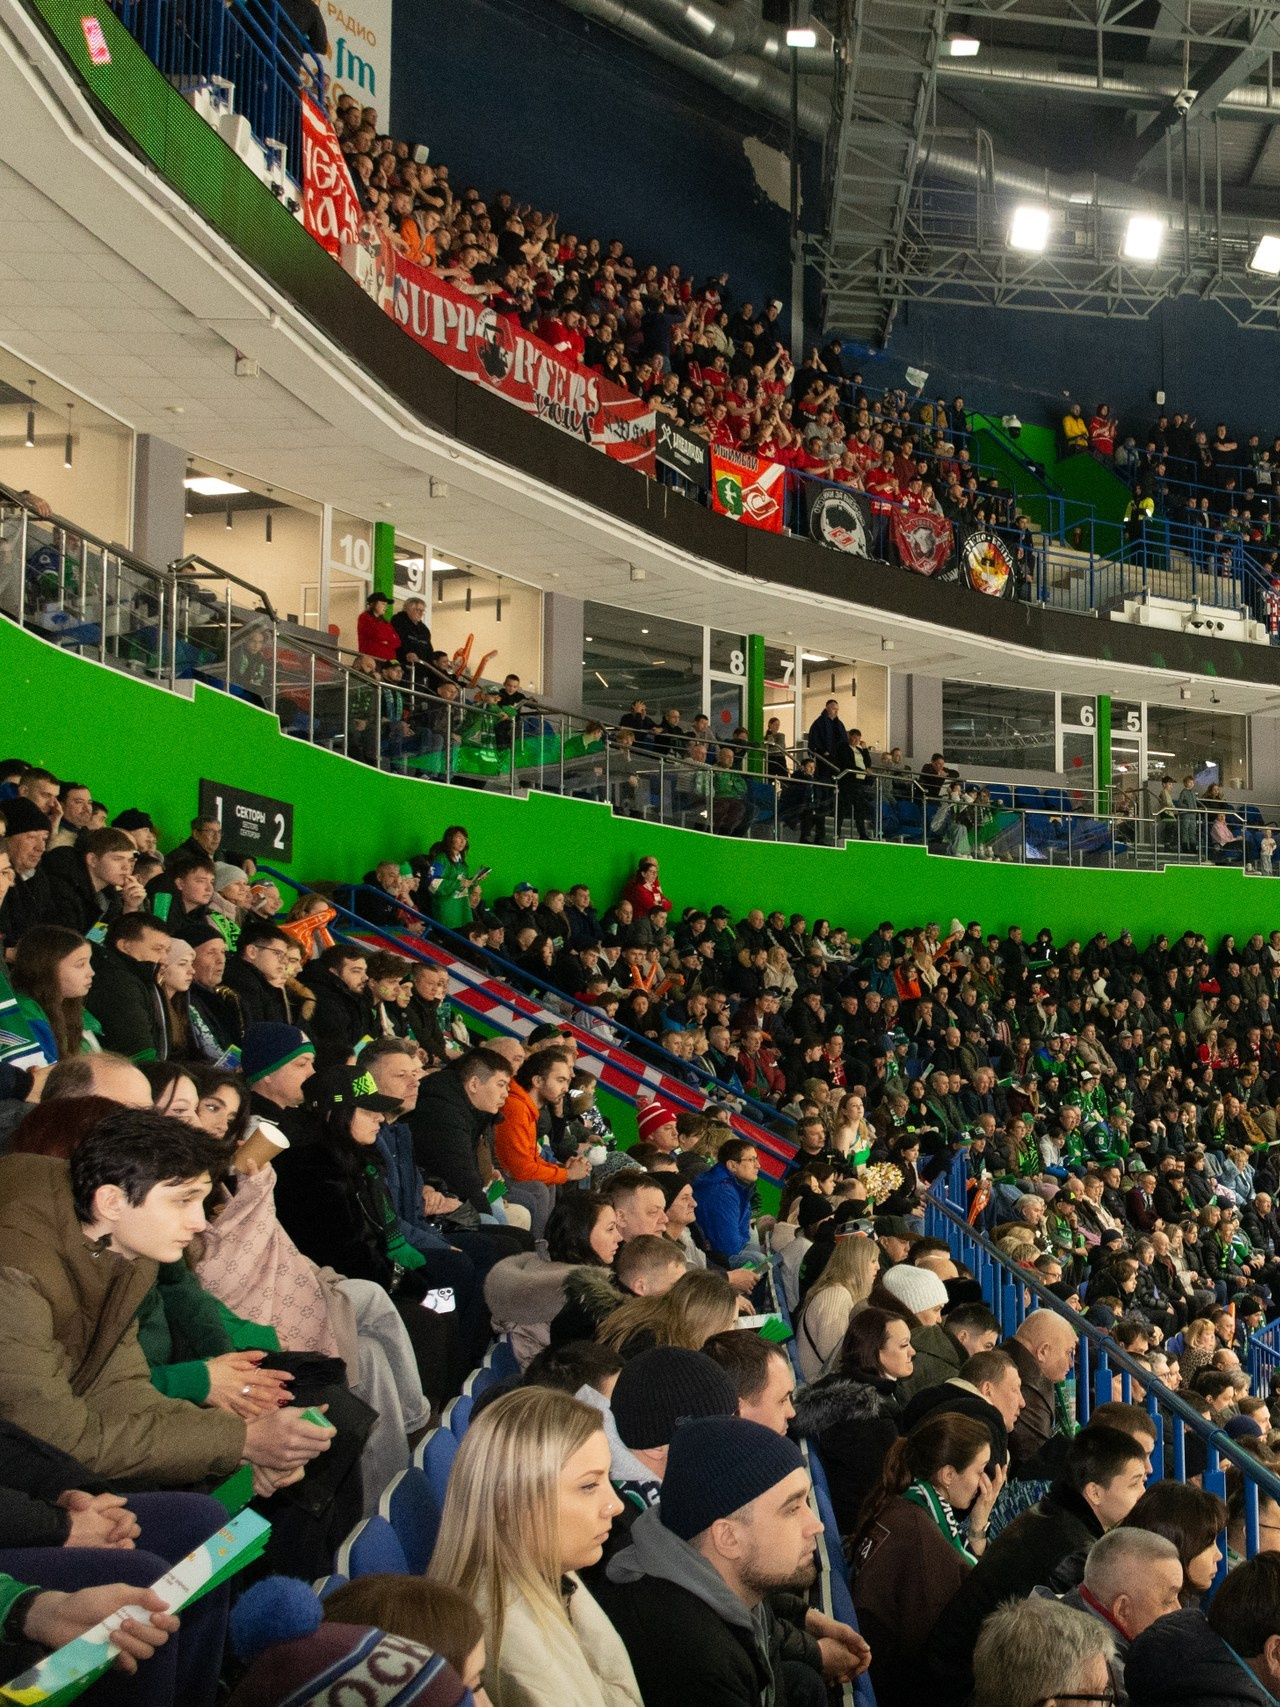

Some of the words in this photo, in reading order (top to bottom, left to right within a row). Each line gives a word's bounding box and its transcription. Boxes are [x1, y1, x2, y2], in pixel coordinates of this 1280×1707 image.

[327, 1, 377, 48] РАДИО
[340, 534, 371, 571] 10
[407, 561, 422, 592] 9
[730, 650, 744, 675] 8
[780, 660, 795, 685] 7
[1080, 705, 1095, 727] 6
[1127, 711, 1140, 732] 5
[215, 795, 223, 830] 1
[236, 804, 266, 824] СЕКТОРЫ
[274, 813, 285, 850] 2
